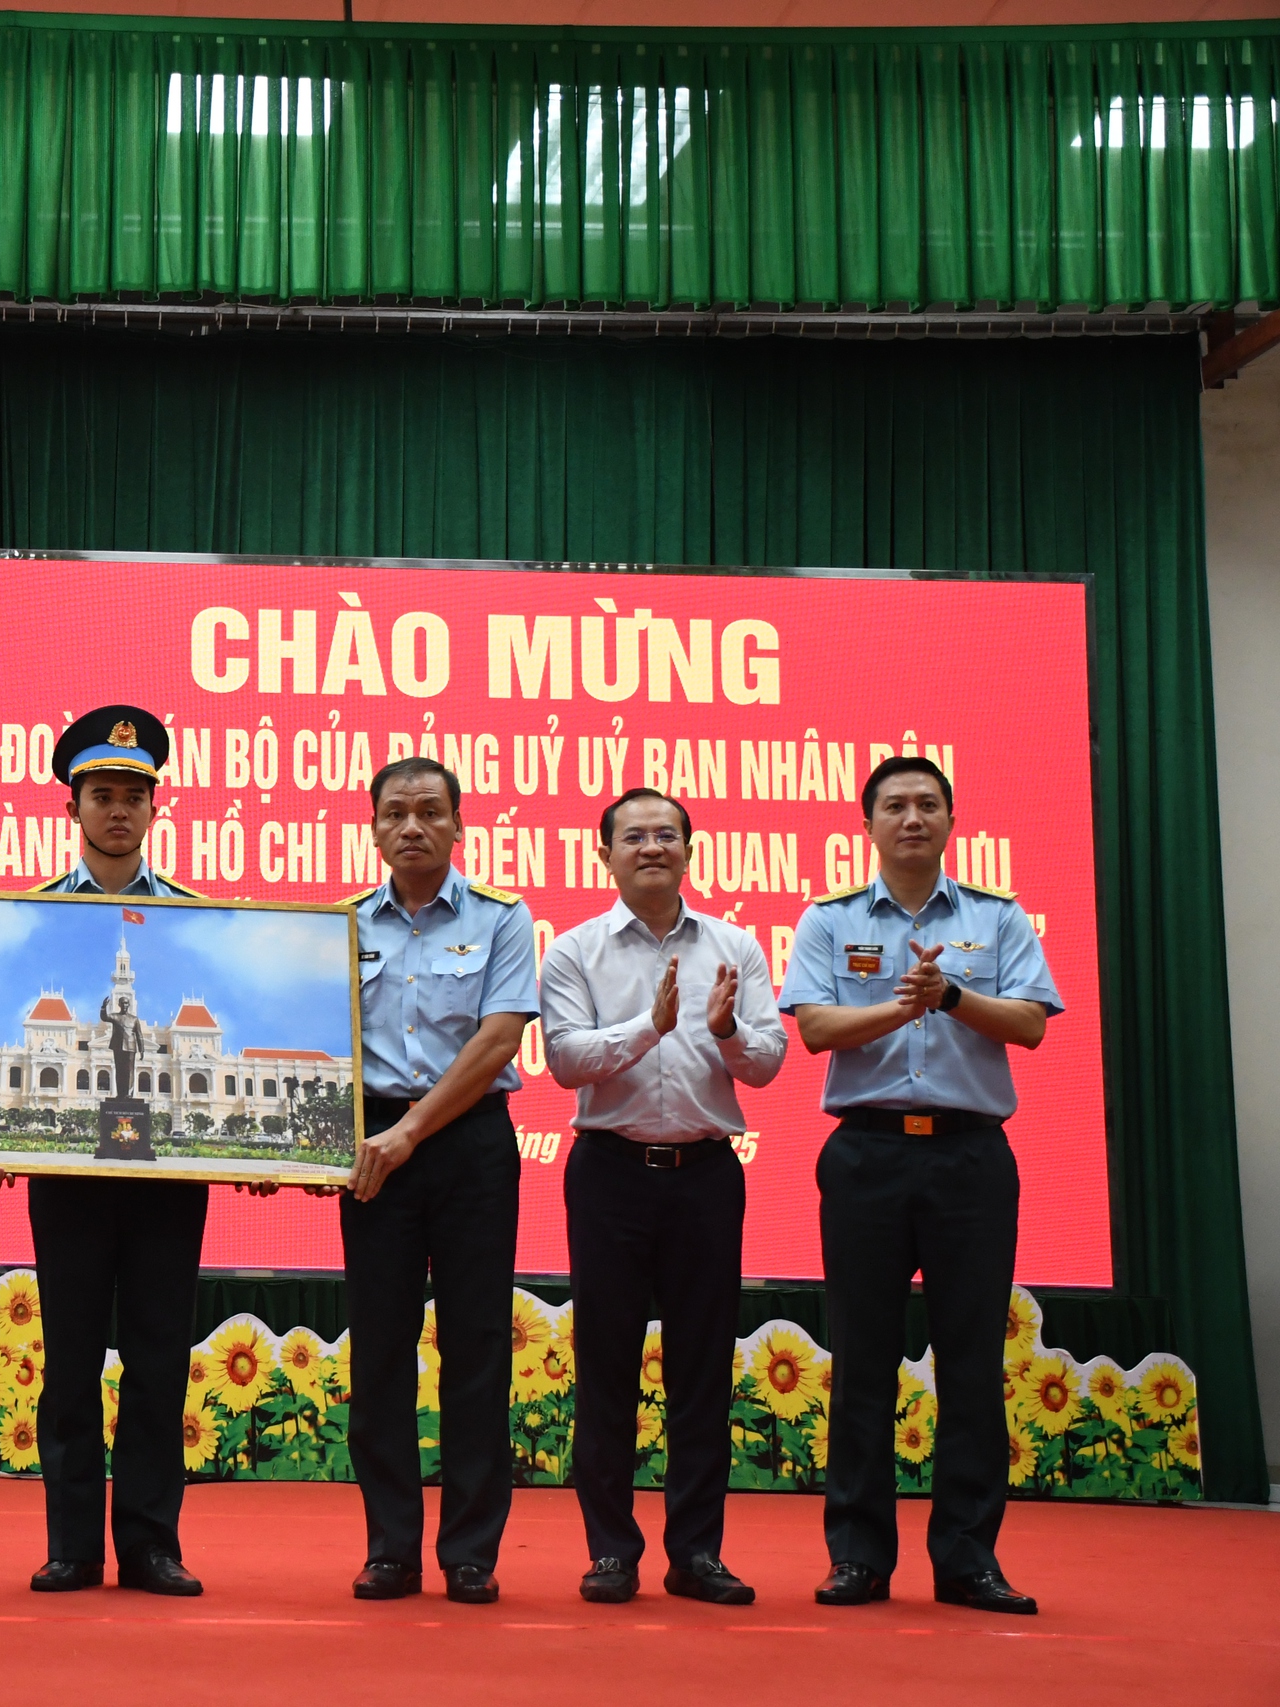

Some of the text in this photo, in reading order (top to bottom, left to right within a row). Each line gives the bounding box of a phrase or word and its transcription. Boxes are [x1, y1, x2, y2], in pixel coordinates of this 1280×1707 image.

[191, 591, 781, 705] CHÀO MỪNG
[0, 711, 74, 785] ĐO
[156, 713, 211, 788] ÁN
[225, 716, 279, 804] BỘ
[293, 709, 373, 791] CỦA
[513, 714, 565, 796] UỶ
[578, 716, 629, 797] UỶ
[643, 738, 727, 799] BAN
[740, 728, 856, 802] NHÂN
[192, 799, 245, 882] HỒ
[259, 809, 327, 883] CHÍ
[463, 806, 546, 888] ĐẾN
[558, 828, 618, 889] TH
[688, 830, 811, 902] QUAN,
